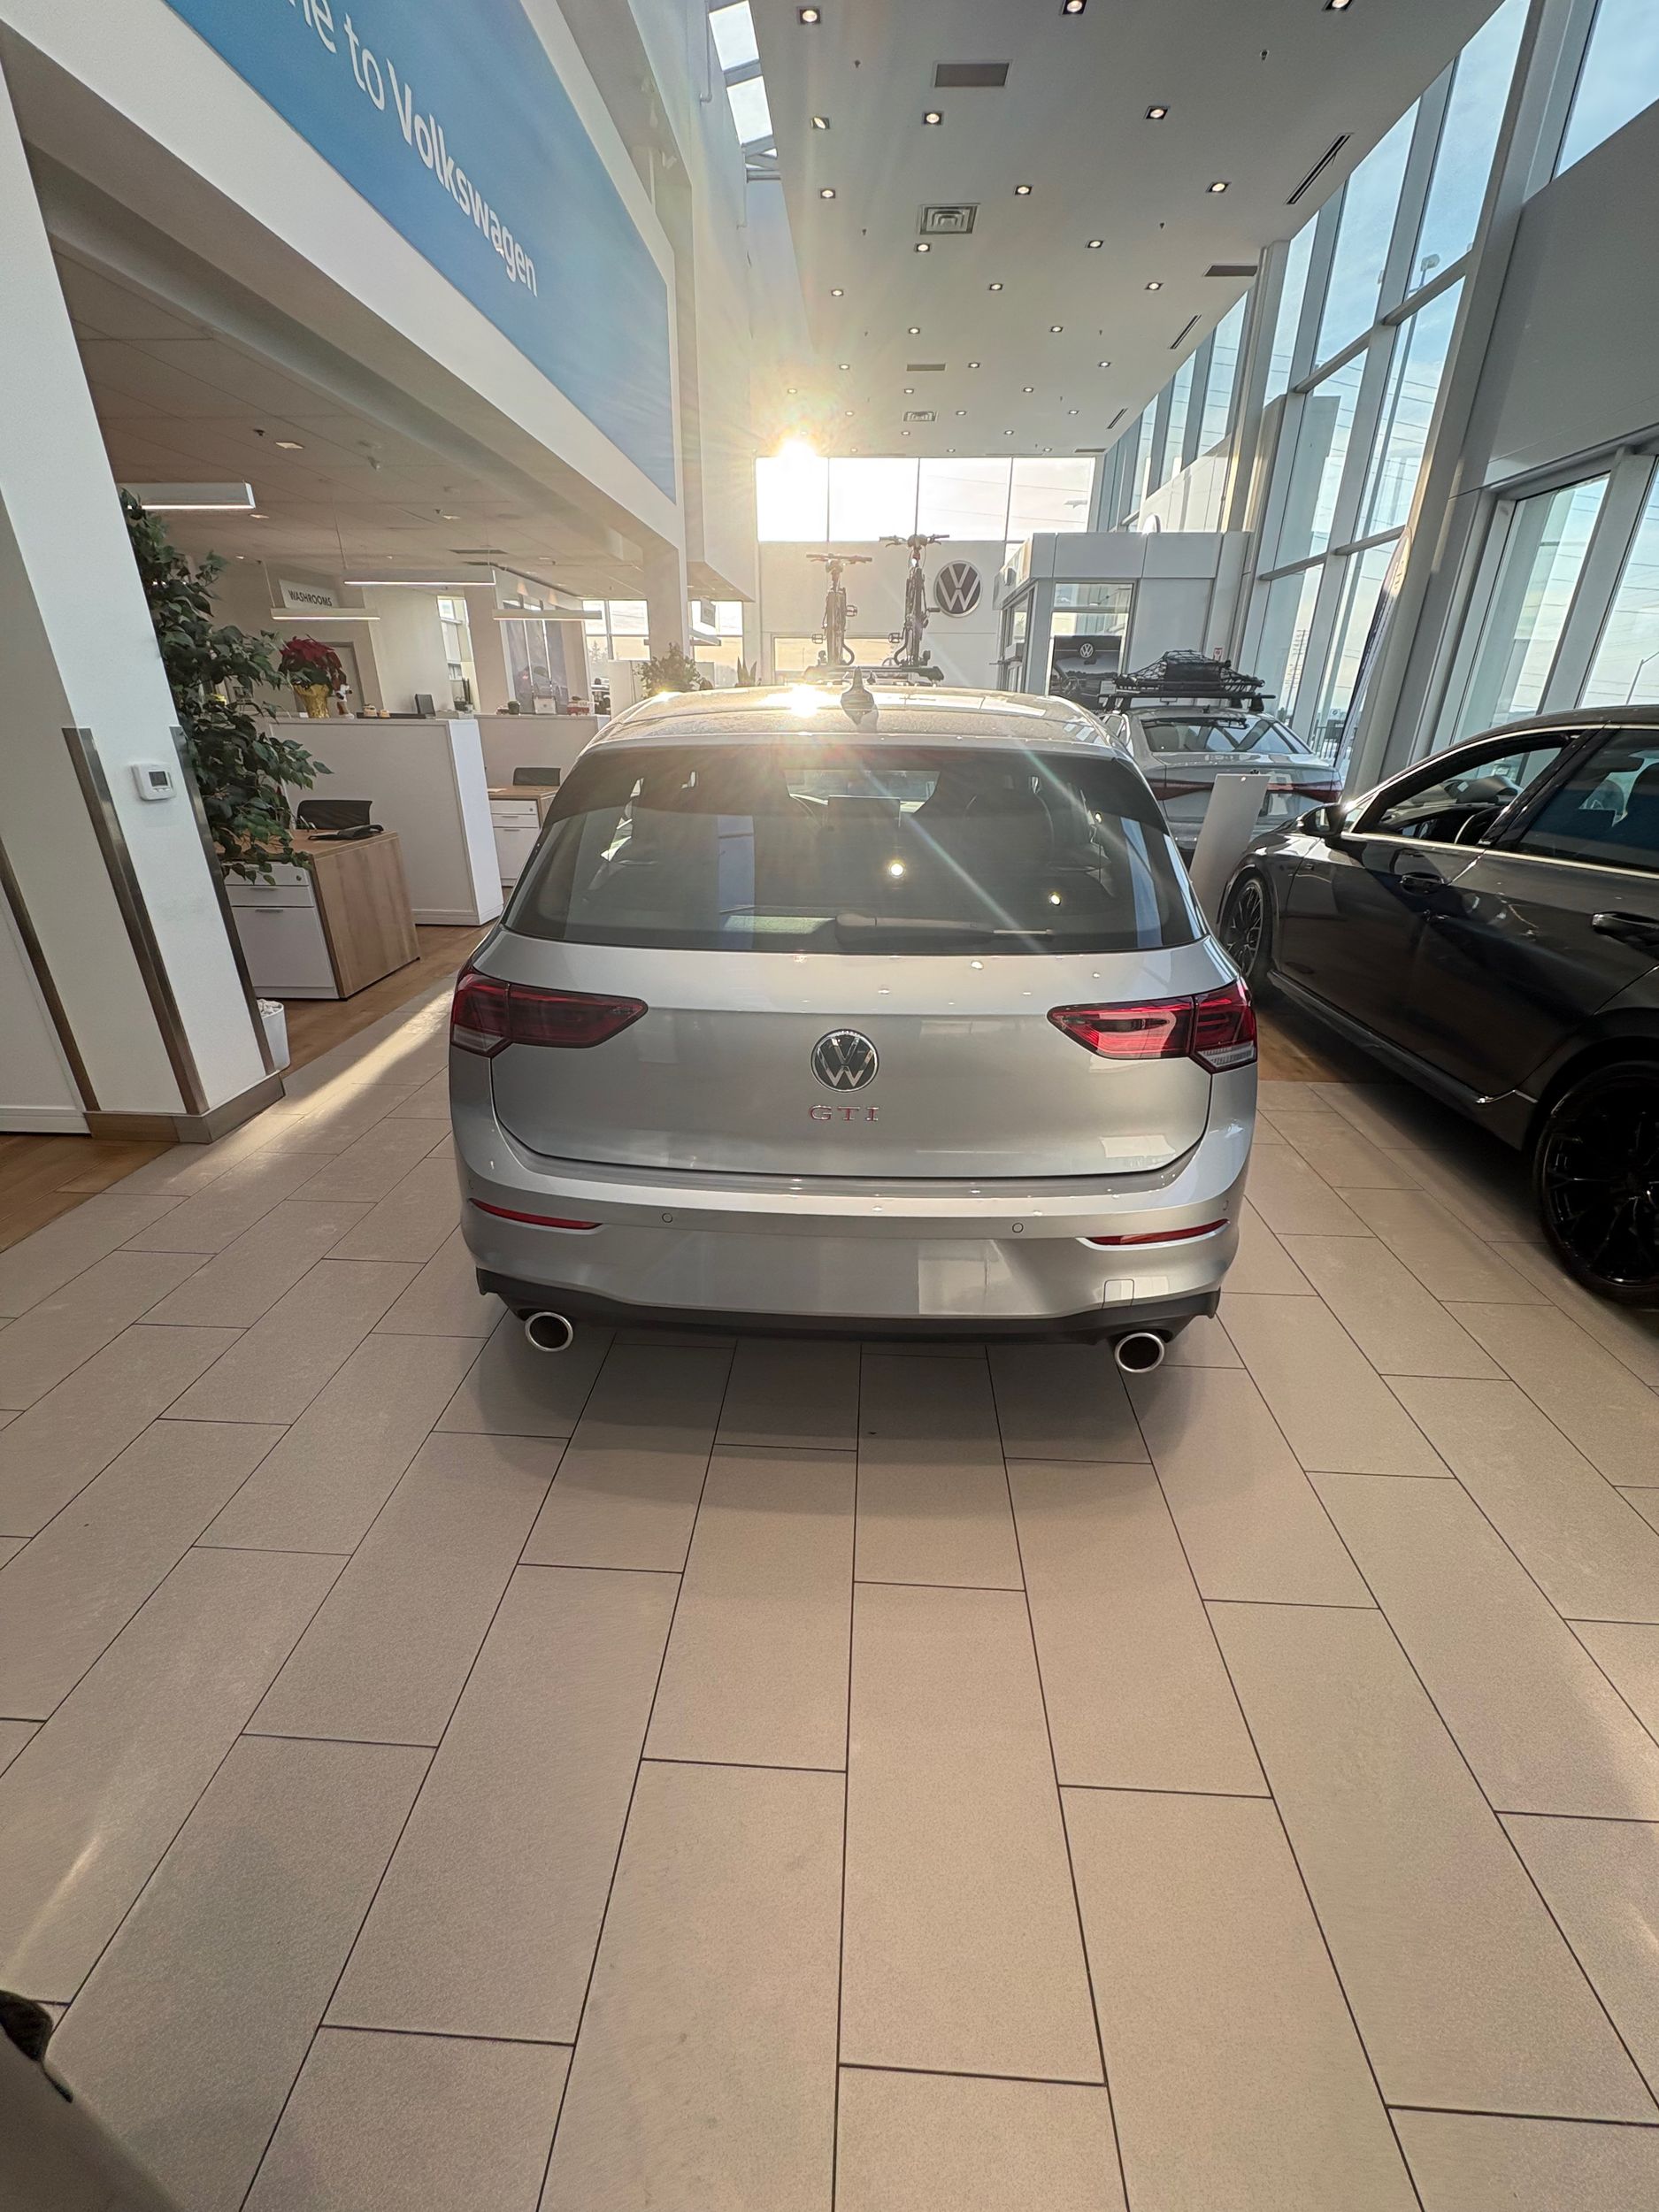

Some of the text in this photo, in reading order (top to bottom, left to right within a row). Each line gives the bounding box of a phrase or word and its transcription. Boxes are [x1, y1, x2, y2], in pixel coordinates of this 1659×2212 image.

[344, 12, 384, 111] to
[387, 58, 538, 298] Volkswagen
[288, 589, 333, 606] WASHROOMS
[809, 1104, 879, 1121] GTI
